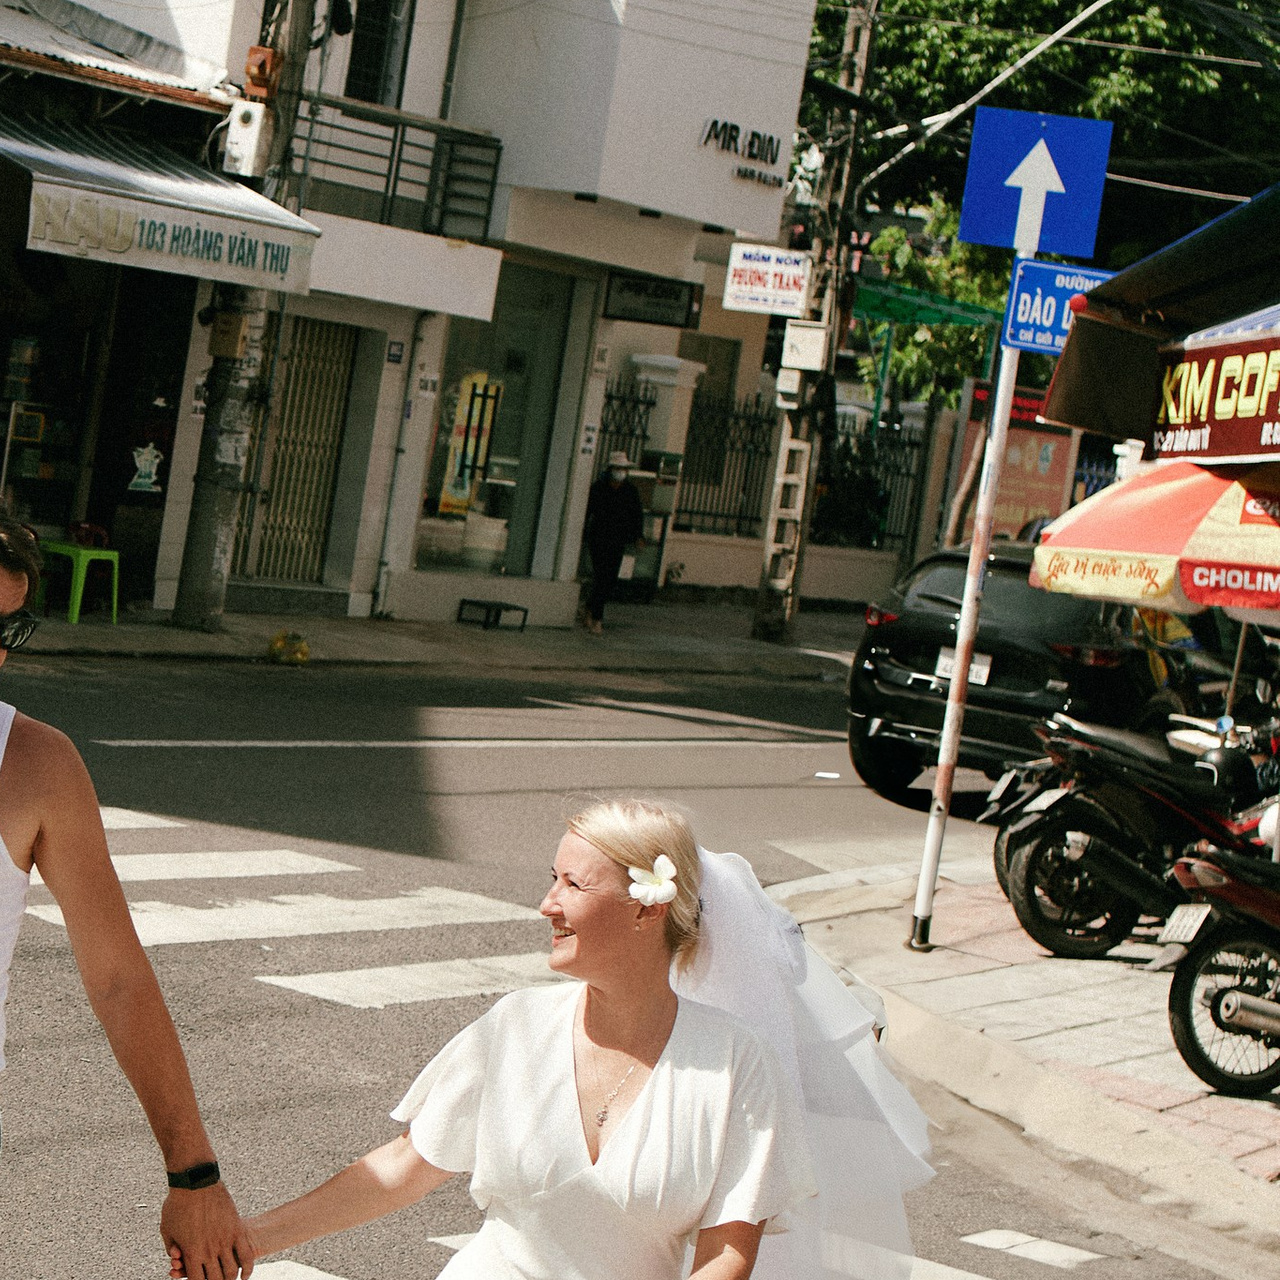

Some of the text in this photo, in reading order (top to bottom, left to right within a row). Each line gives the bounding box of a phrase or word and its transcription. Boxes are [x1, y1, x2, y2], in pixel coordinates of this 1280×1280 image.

[137, 218, 167, 252] 103
[170, 222, 223, 263] HOÀNG
[227, 231, 259, 268] VĂN
[262, 241, 292, 281] THỤ
[1017, 287, 1057, 328] ĐÀO
[1157, 358, 1216, 425] KIM
